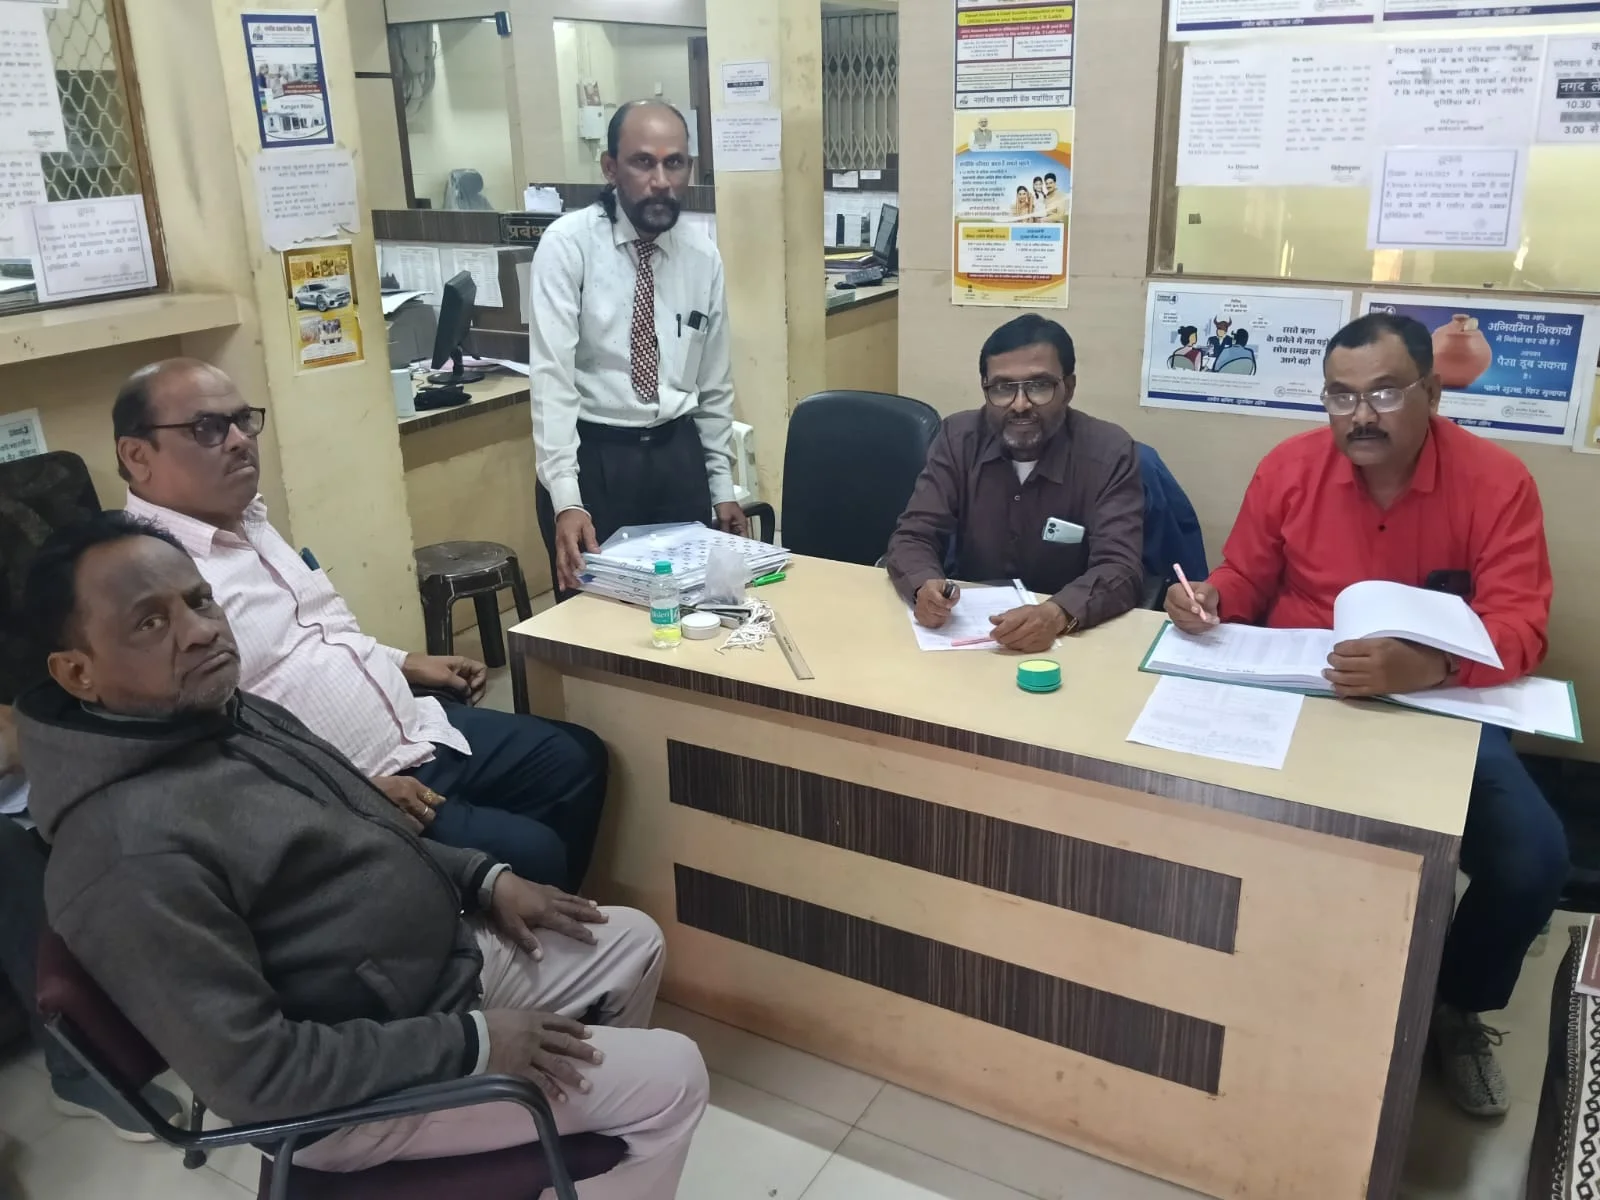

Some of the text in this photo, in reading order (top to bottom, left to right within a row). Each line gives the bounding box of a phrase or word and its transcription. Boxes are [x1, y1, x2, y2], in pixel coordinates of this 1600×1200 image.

[1566, 100, 1591, 109] 10.30
[1488, 320, 1573, 336] अनियमित निकायों
[1497, 355, 1516, 367] पैसा
[1537, 360, 1568, 371] सकता
